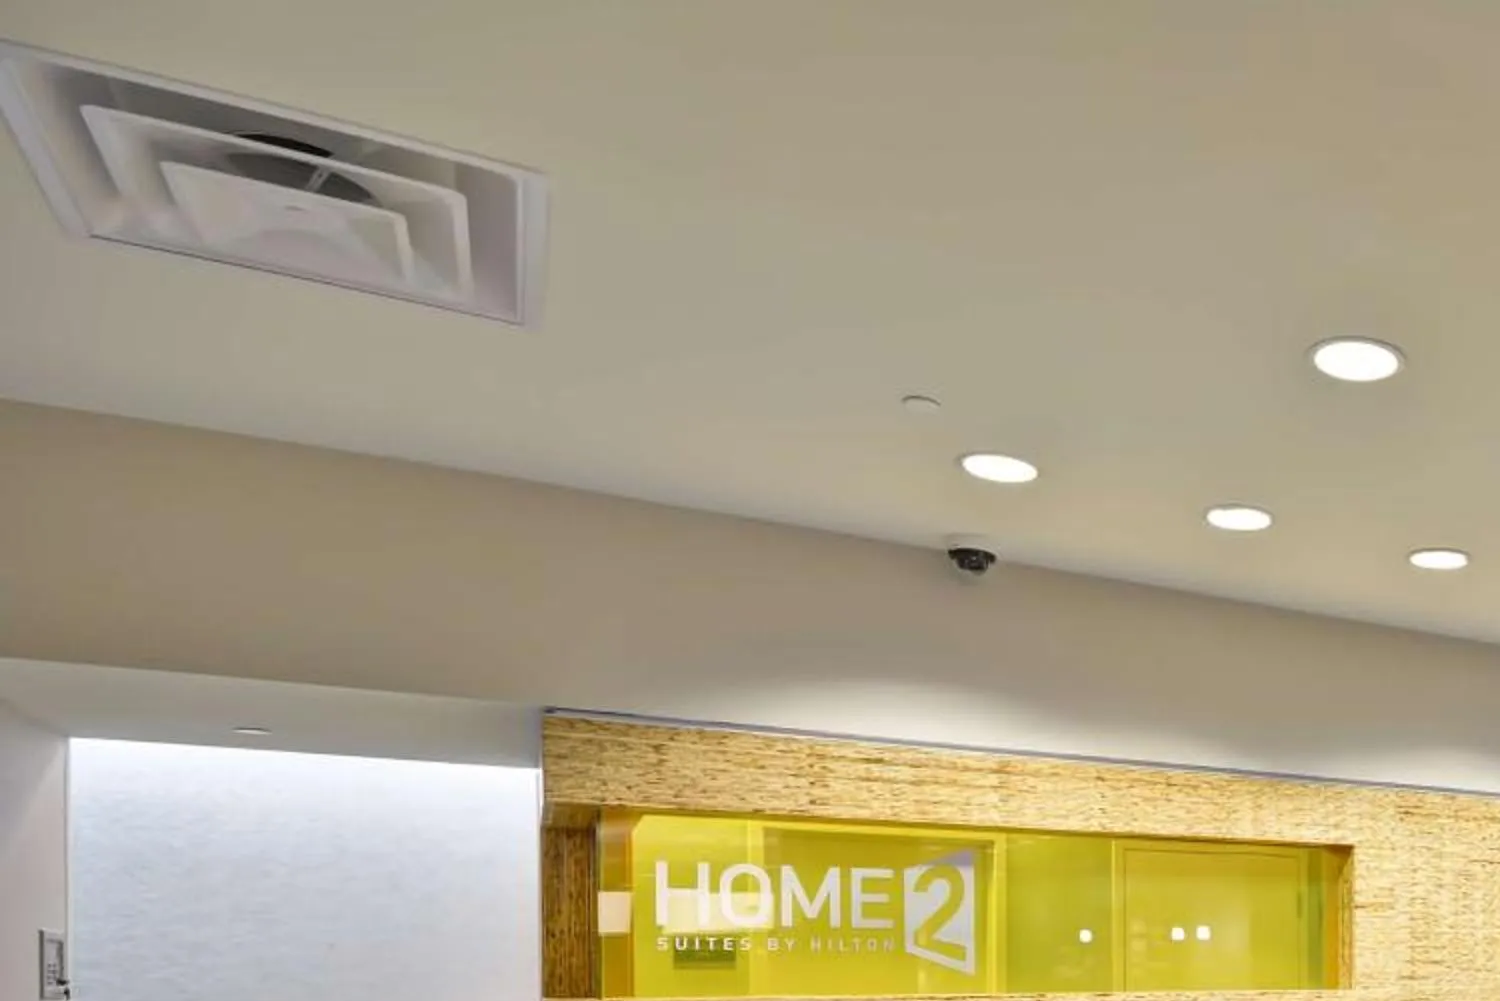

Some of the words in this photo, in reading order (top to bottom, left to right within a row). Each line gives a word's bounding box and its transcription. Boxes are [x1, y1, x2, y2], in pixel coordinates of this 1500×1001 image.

[655, 860, 895, 930] HOME
[910, 861, 970, 964] 2
[656, 936, 752, 952] SUITES
[767, 937, 797, 953] BY
[810, 938, 896, 954] HILTON
